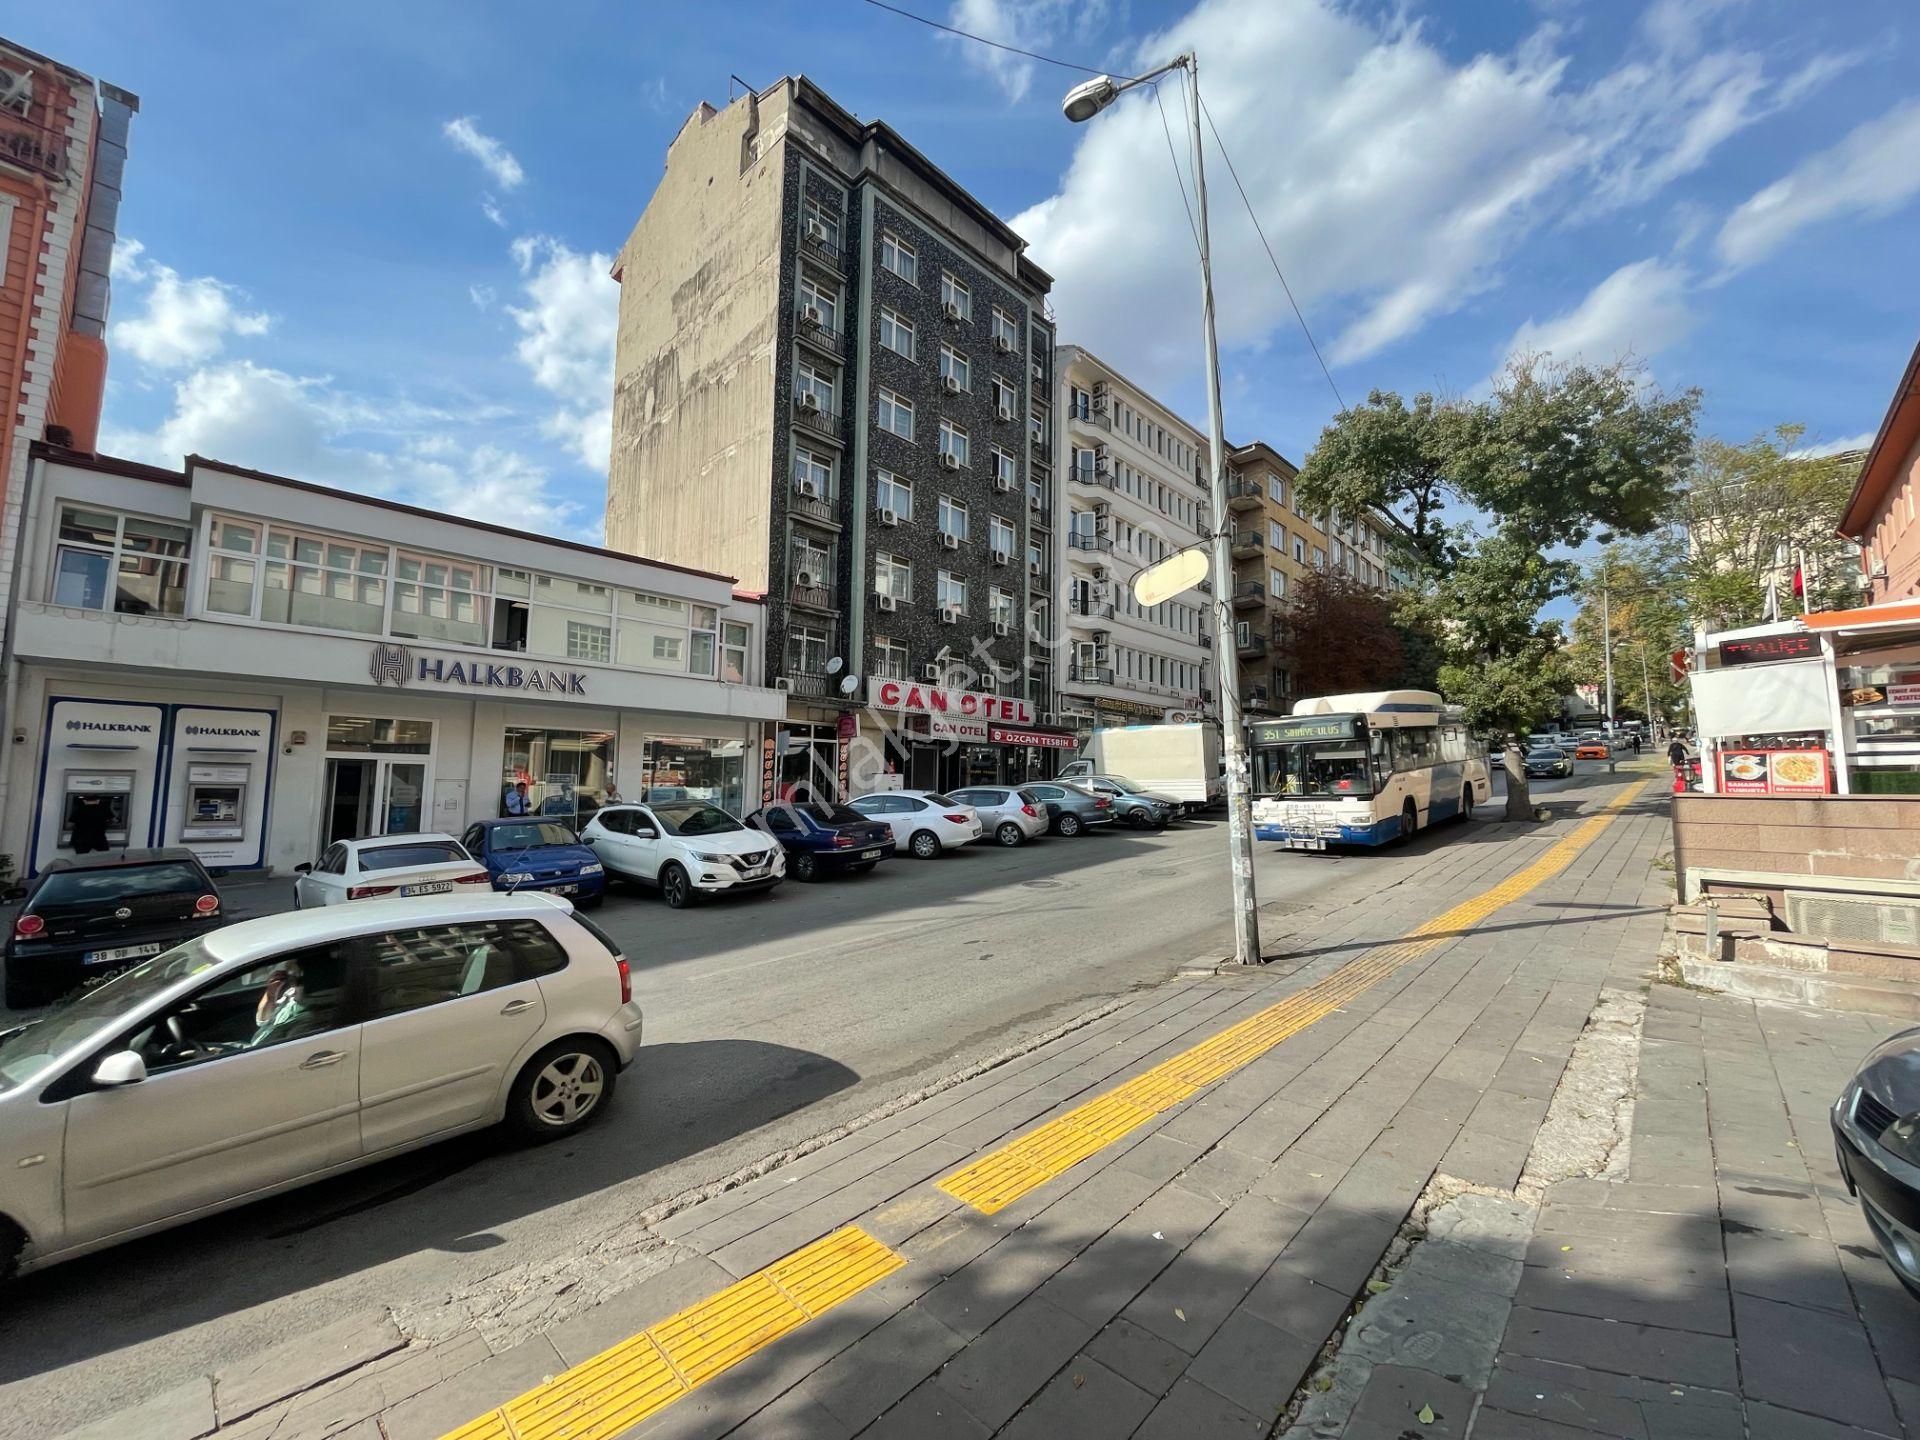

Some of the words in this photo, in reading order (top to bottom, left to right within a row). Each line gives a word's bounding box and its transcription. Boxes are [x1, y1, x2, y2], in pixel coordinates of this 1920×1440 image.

[418, 657, 588, 696] HALKBANK
[879, 682, 948, 712] CAN
[960, 694, 1030, 722] OTEL
[82, 722, 151, 733] HALKBANK
[200, 727, 261, 737] HALKBANK
[933, 722, 956, 733] CAN
[959, 725, 986, 736] OTEL
[1264, 729, 1279, 739] 351
